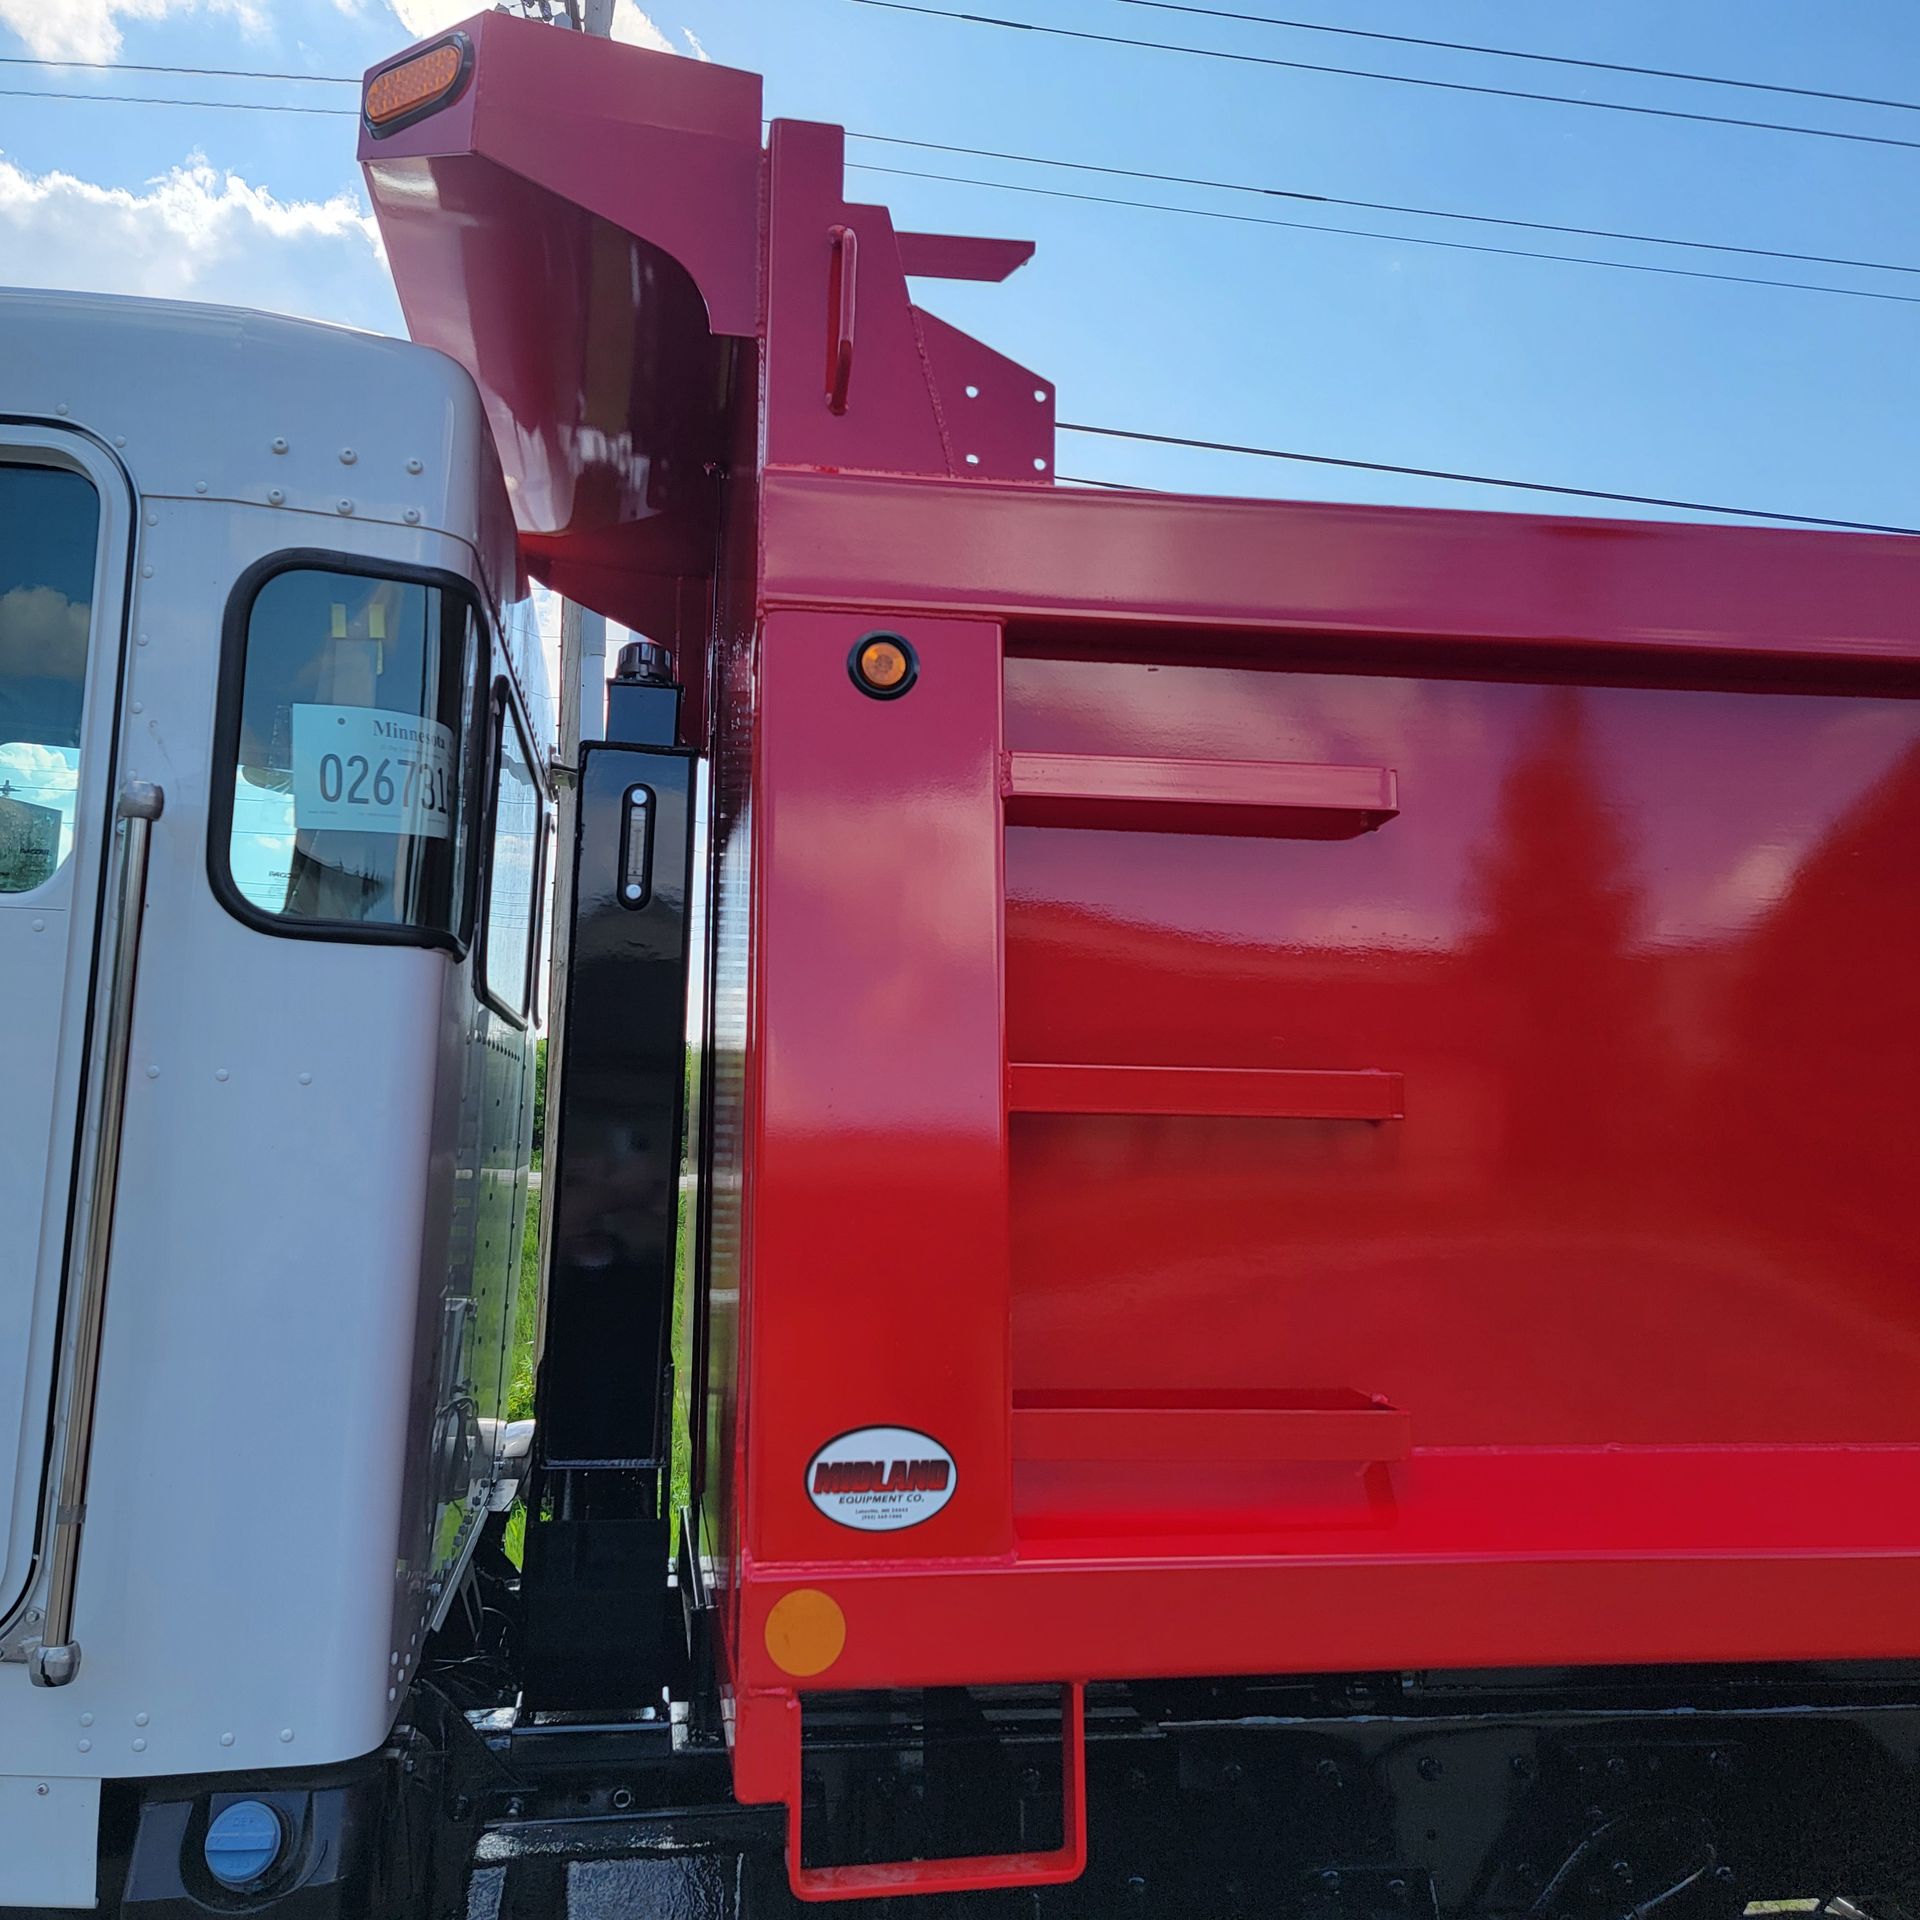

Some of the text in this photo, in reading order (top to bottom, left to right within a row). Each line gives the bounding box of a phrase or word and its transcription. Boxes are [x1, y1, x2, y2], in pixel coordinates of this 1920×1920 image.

[373, 719, 446, 750] Minnesota
[319, 753, 447, 814] 026731
[813, 1459, 950, 1495] MIDLAND
[838, 1493, 925, 1505] EQUIPMENT CO.
